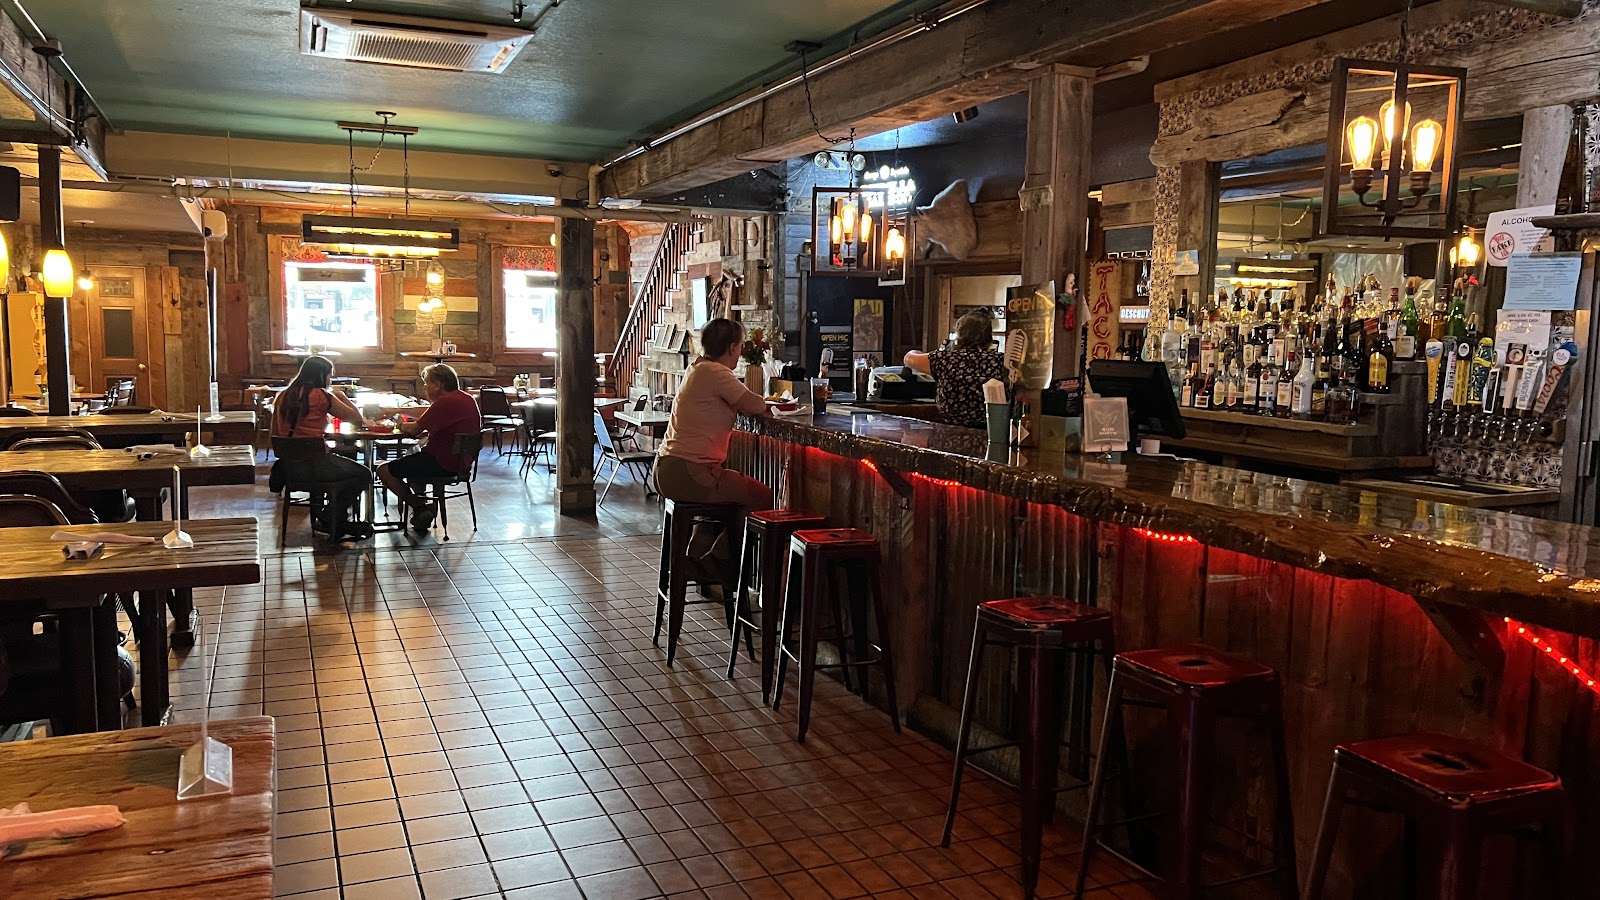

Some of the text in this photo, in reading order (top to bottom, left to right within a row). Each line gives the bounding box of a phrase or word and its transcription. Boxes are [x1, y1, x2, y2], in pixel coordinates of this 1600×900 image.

[1501, 216, 1535, 226] ALCOHO
[1491, 239, 1513, 253] FAKE
[1008, 297, 1035, 313] OPEN
[1120, 308, 1150, 319] DESCHUT
